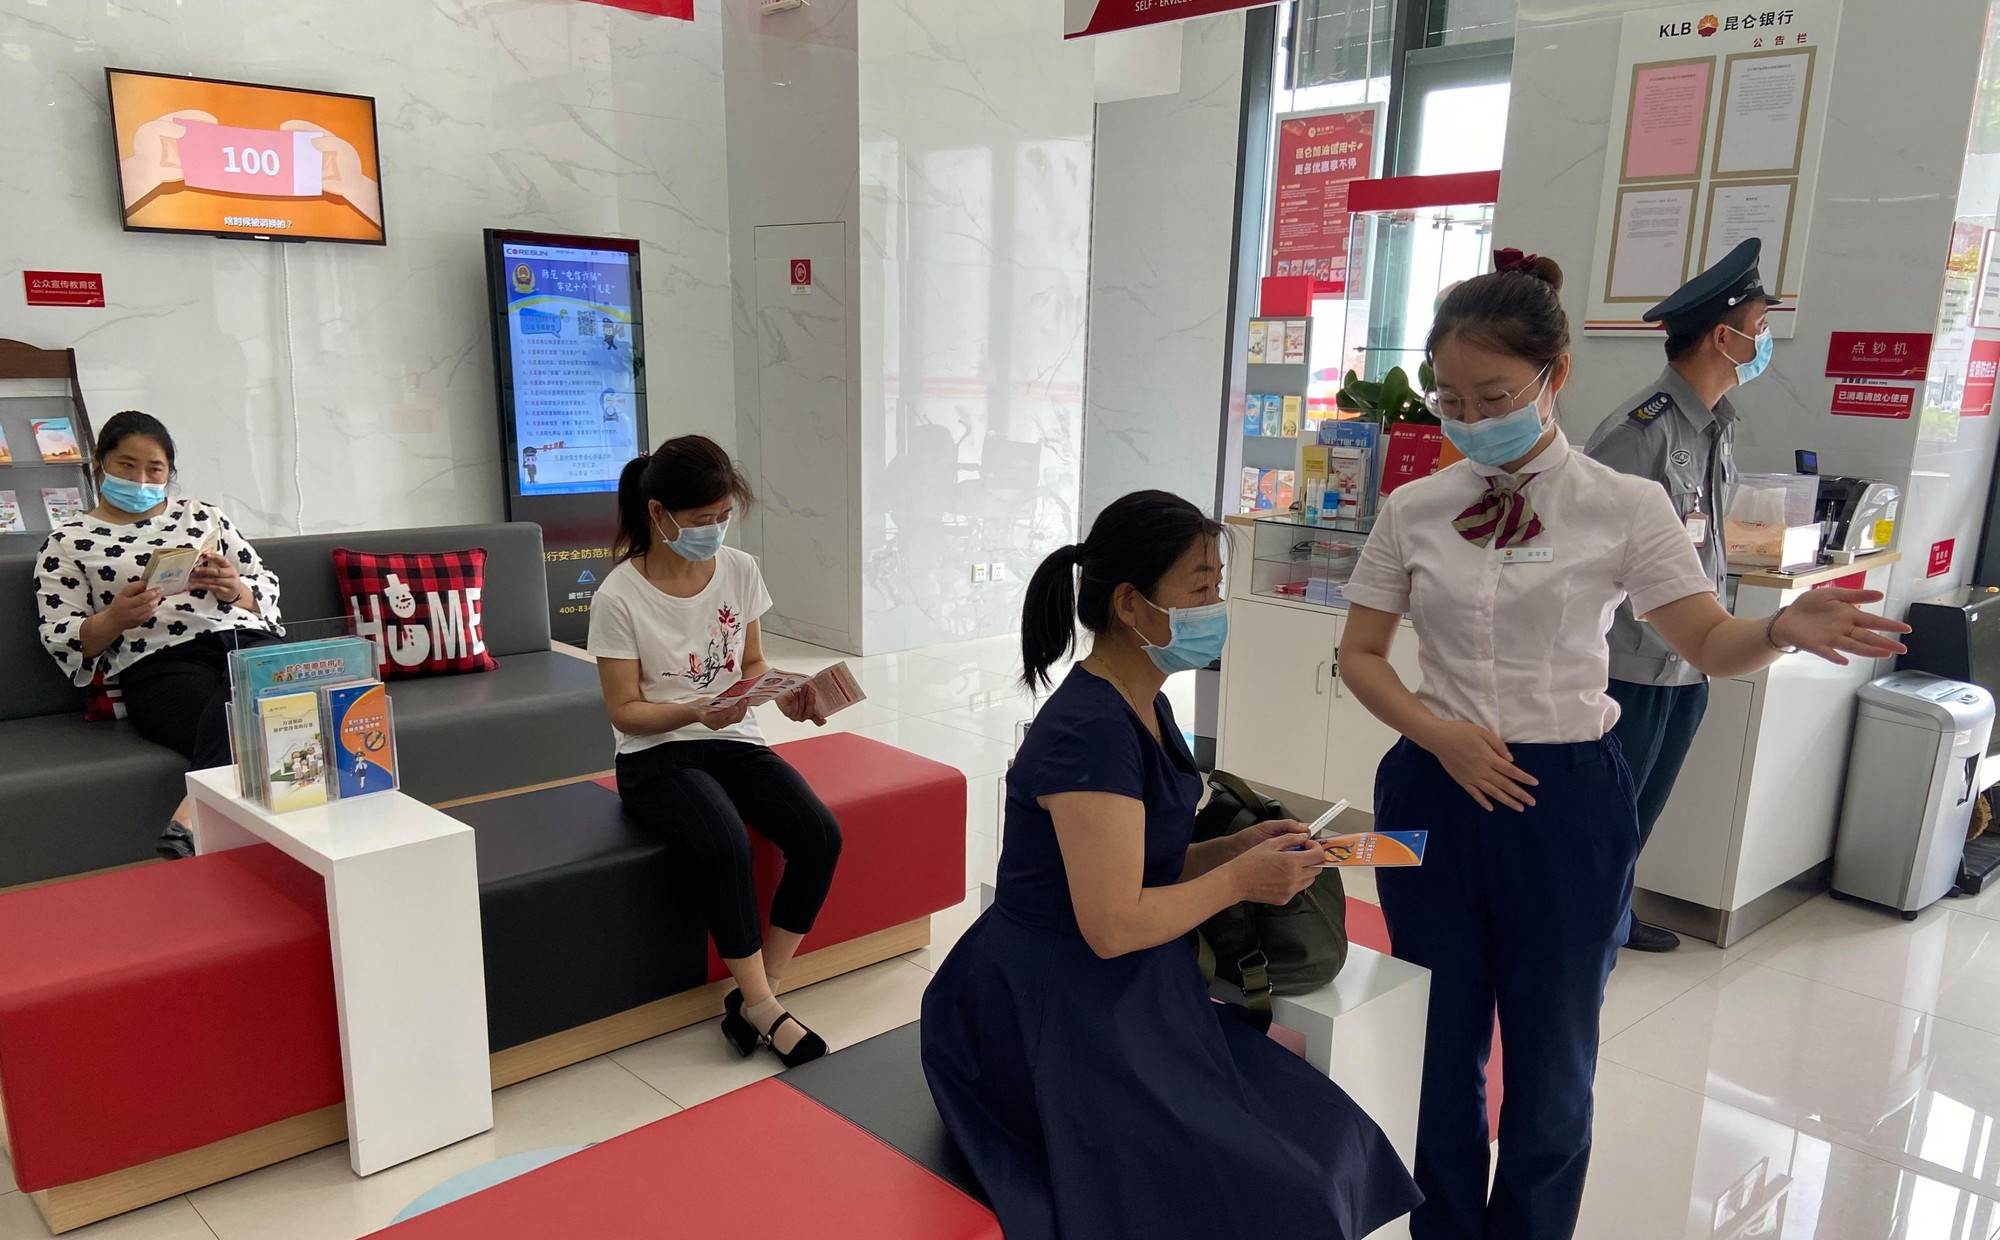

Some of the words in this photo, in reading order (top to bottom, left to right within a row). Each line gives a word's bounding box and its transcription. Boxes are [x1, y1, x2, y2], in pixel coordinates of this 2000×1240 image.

[1135, 0, 1153, 12] SELF
[1659, 22, 1692, 38] KLB
[1723, 9, 1794, 31] 昆仑银行
[1753, 32, 1808, 48] 公告栏
[1295, 141, 1357, 160] 昆仑加油信用卡
[222, 146, 280, 176] 100
[1294, 157, 1357, 176] 更多优惠享不停
[506, 247, 548, 257] CORESUN
[31, 279, 98, 290] 公众宣传教育区
[1851, 340, 1908, 356] 点钞机
[1838, 390, 1910, 404] 已消毒请放心使用
[568, 591, 597, 600] 盛世三
